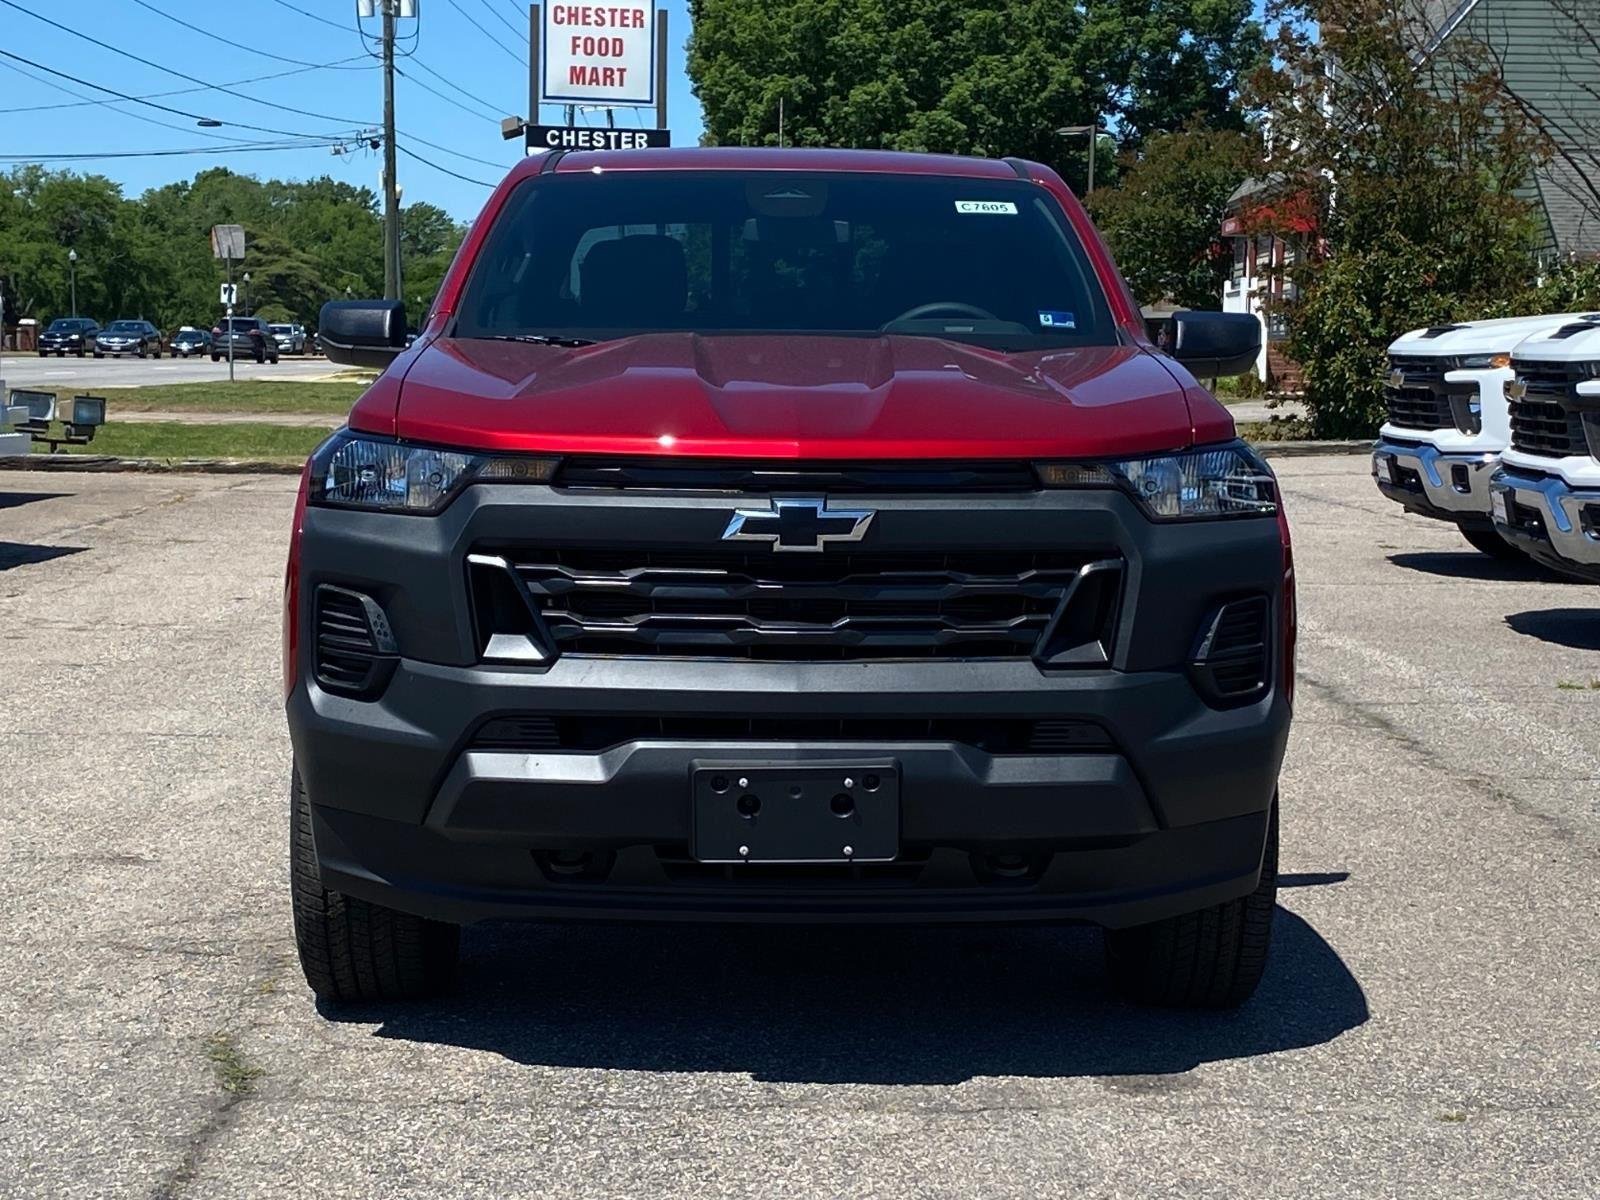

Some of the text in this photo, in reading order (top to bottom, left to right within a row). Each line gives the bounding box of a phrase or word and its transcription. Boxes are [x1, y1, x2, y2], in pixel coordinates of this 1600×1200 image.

[553, 5, 645, 28] CHESTER
[571, 36, 624, 57] FOOD
[569, 66, 627, 87] MART
[546, 130, 648, 149] CHESTER
